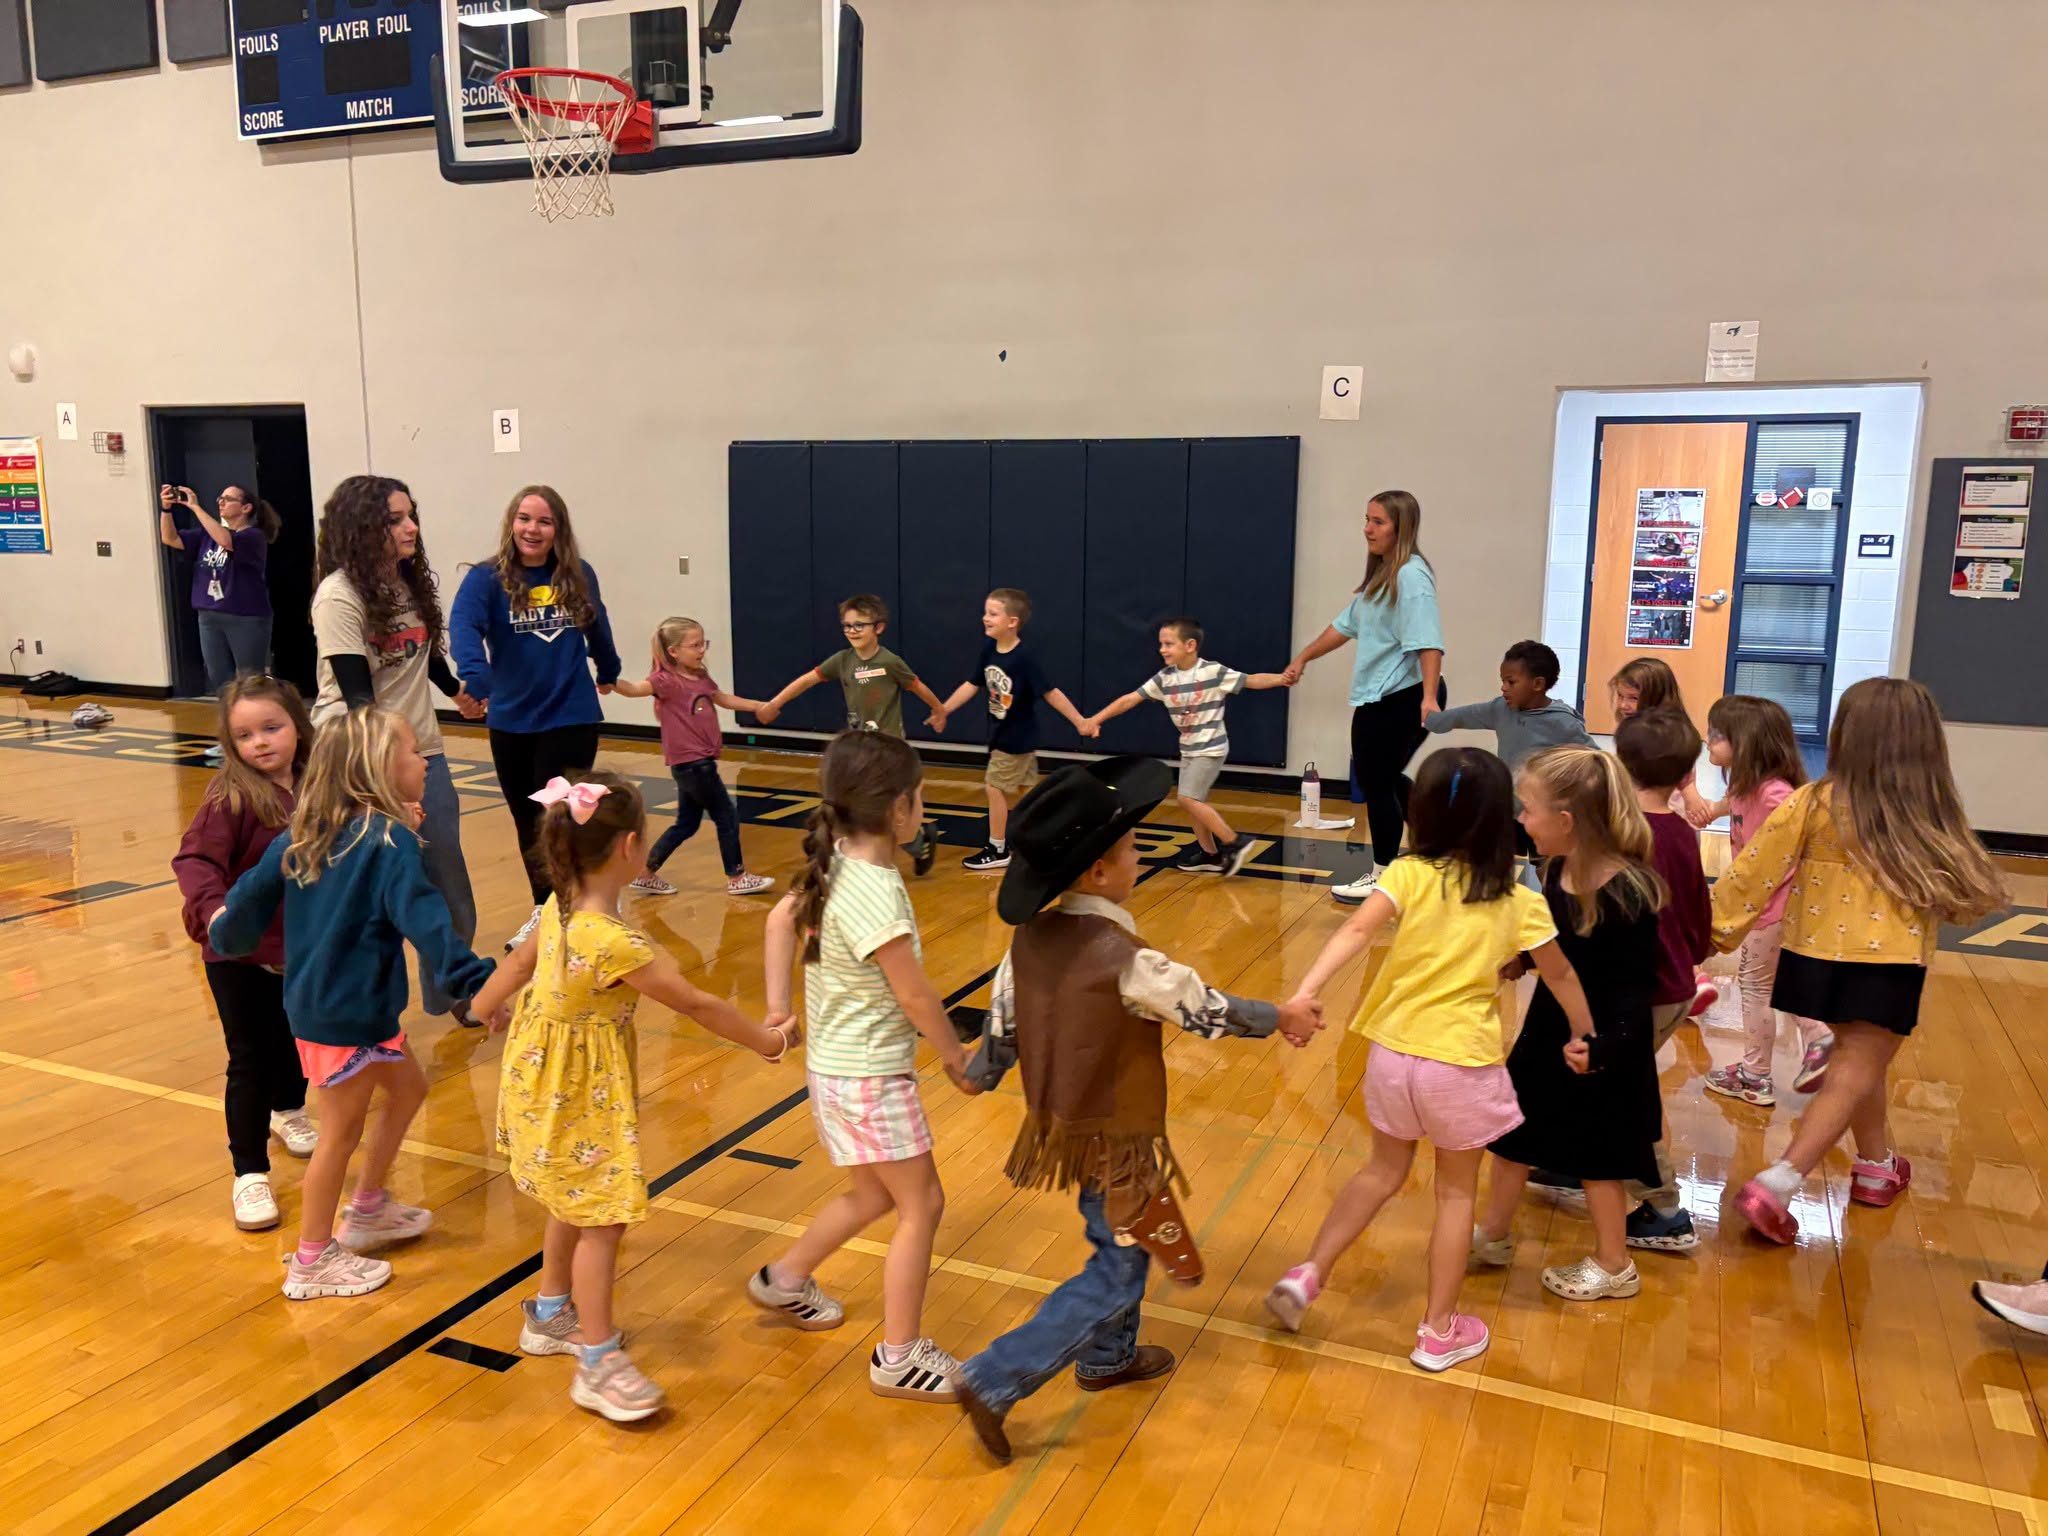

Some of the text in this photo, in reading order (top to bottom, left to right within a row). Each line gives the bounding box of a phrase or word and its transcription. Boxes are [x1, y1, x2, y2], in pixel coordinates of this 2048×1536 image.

[319, 14, 412, 44] PLAYER FOUL
[239, 33, 279, 56] FOULS
[346, 97, 393, 120] MATCH
[244, 110, 284, 131] SCORE
[1333, 377, 1350, 397] C
[62, 410, 72, 425] A
[500, 418, 512, 435] B
[509, 607, 546, 624] LADY
